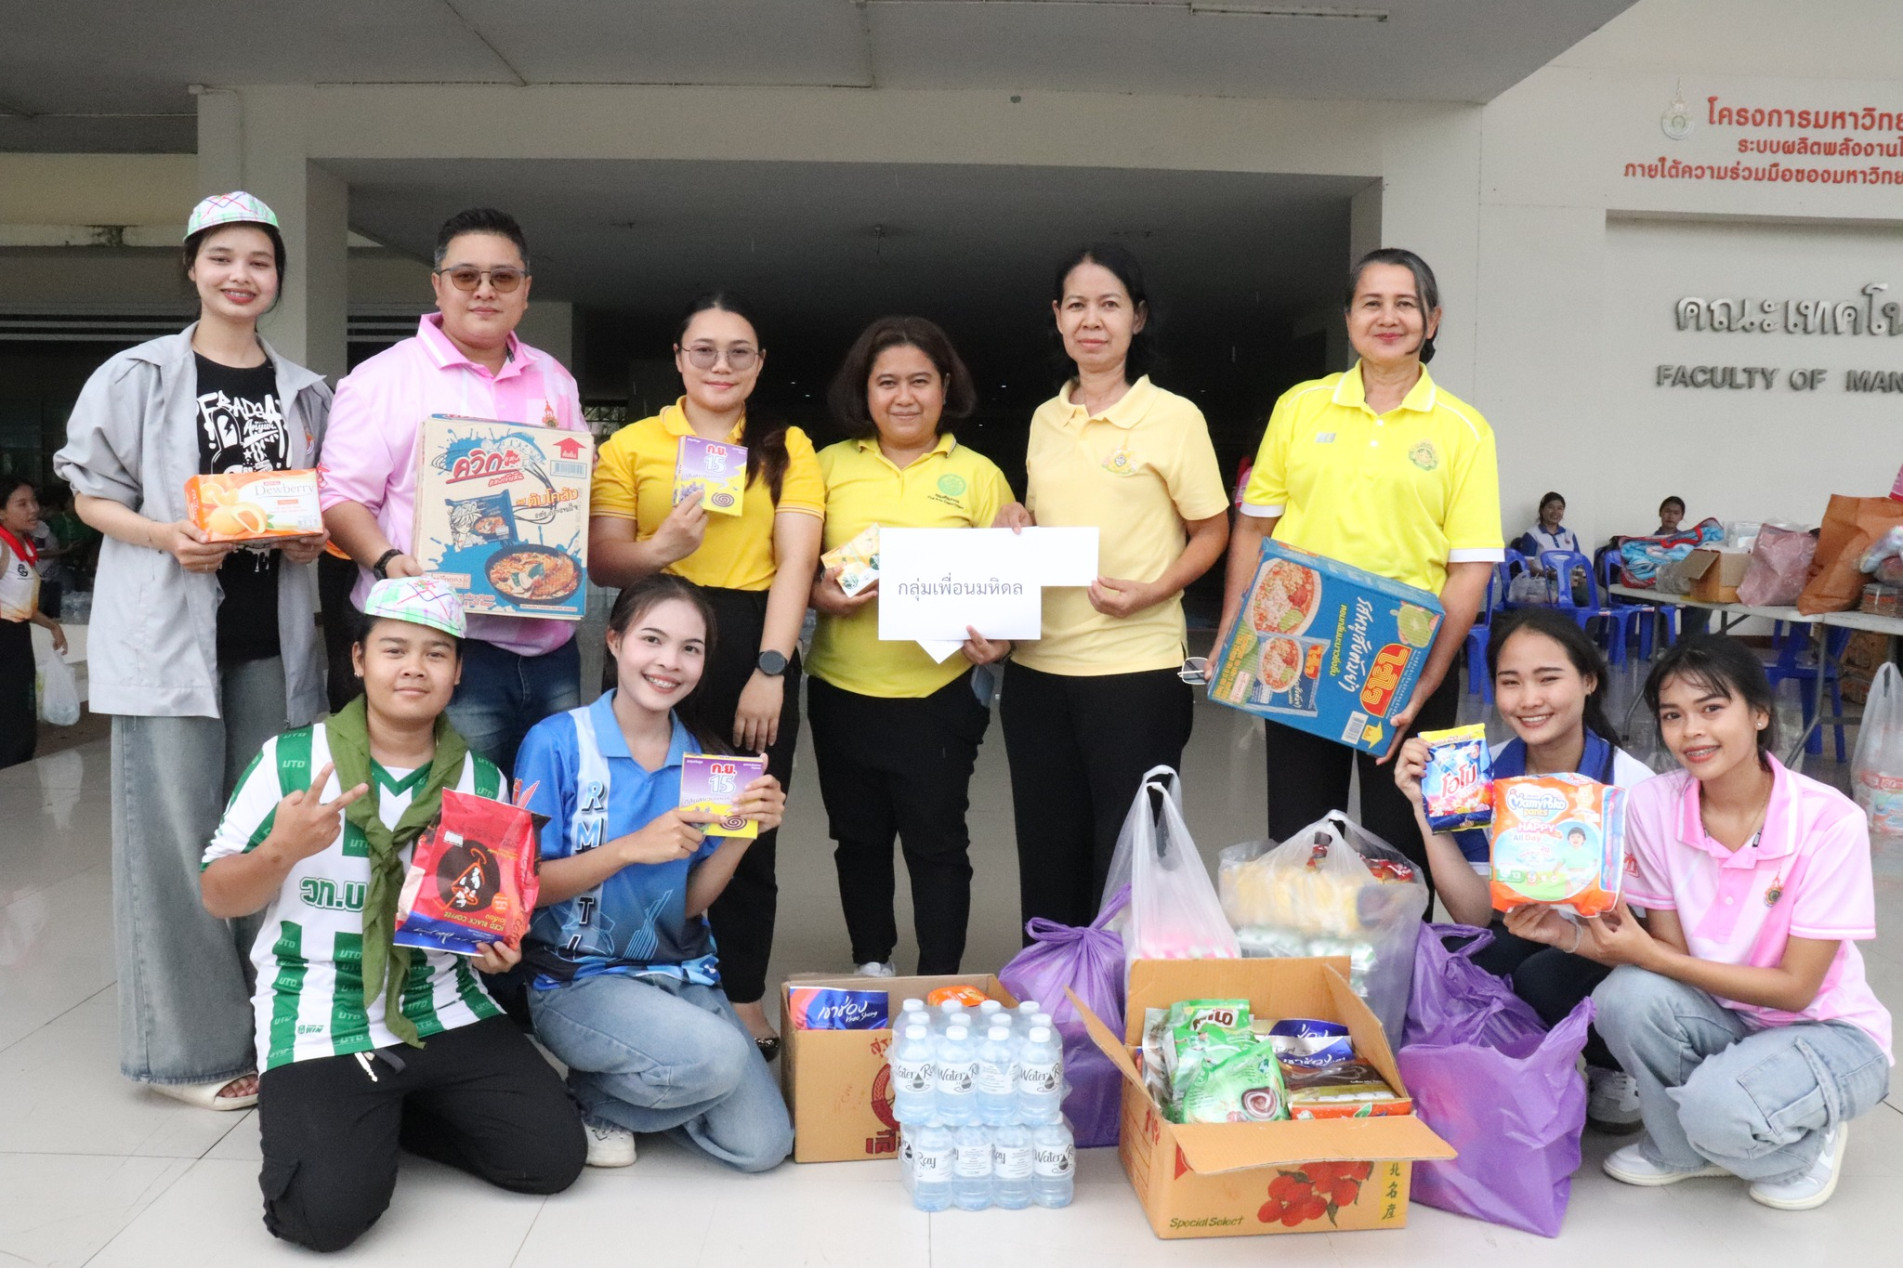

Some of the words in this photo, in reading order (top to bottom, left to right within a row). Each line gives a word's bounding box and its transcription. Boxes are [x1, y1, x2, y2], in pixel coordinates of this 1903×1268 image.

[1656, 365, 1779, 390] FACULTY
[1789, 368, 1827, 391] OF
[704, 455, 726, 473] 15
[255, 482, 315, 497] Dewberry
[898, 572, 1023, 602] กลุ่มเพื่อนมหิดล
[282, 760, 305, 768] UTD
[712, 764, 736, 774] ก.ย.
[709, 775, 736, 793] 15
[1442, 763, 1477, 798] โอโม
[1518, 821, 1556, 833] HAPPY
[350, 839, 369, 848] UT
[444, 911, 467, 922] COFFEE
[470, 918, 488, 927] BLACK
[490, 923, 504, 931] ICED
[817, 995, 868, 1020] เขาช่อง
[938, 1068, 965, 1081] Water
[1020, 1068, 1047, 1082] Water
[918, 1152, 936, 1169] Ray
[1034, 1148, 1062, 1163] Water
[1170, 1217, 1207, 1229] Special
[1209, 1216, 1244, 1227] Select
